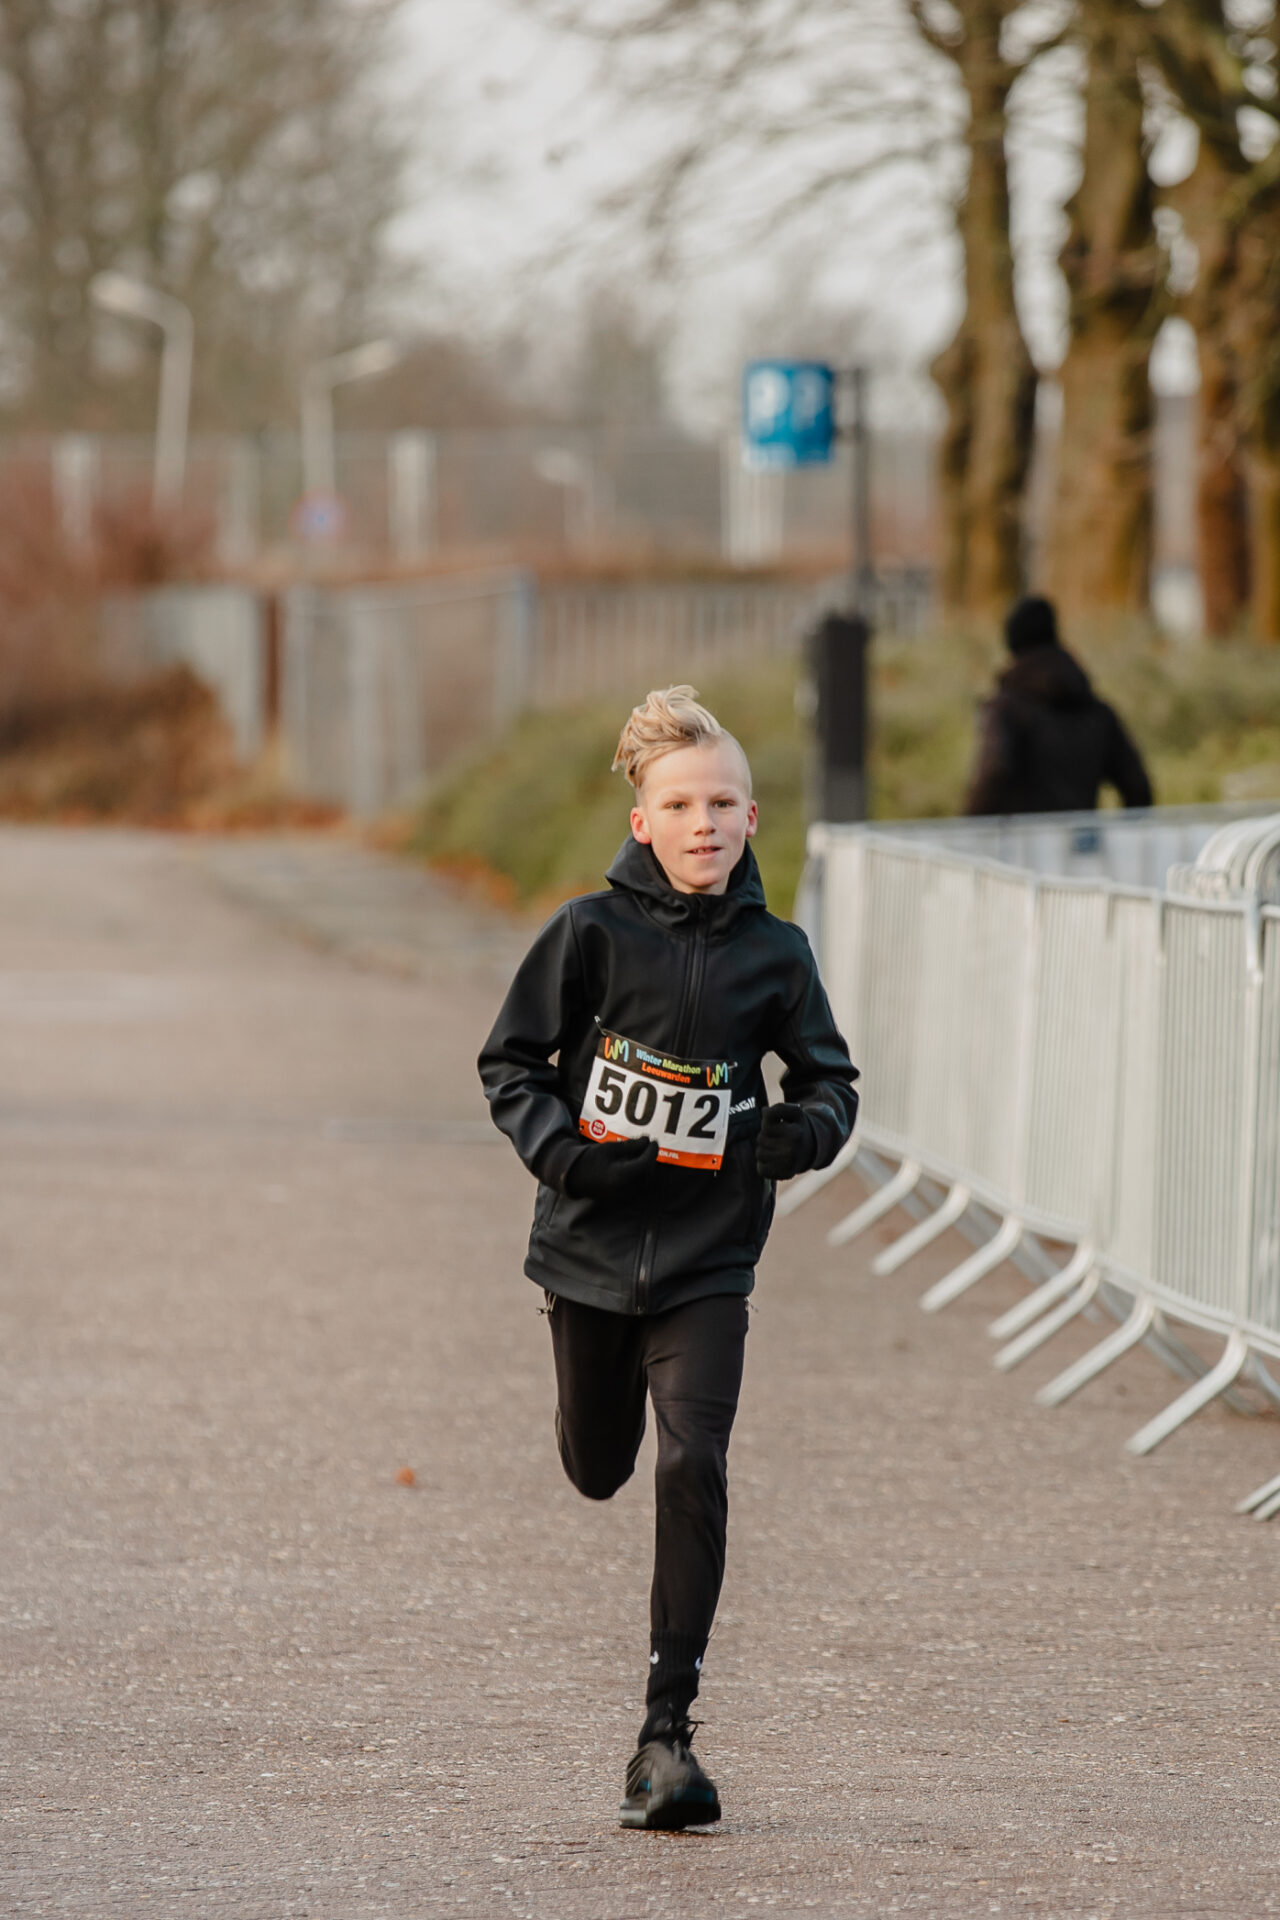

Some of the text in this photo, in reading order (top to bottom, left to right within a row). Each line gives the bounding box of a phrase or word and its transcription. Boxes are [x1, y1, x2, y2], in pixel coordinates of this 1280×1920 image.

[636, 1048, 701, 1074] Winter Marathon
[642, 1062, 690, 1083] Leeuwarden
[595, 1066, 720, 1139] 5012
